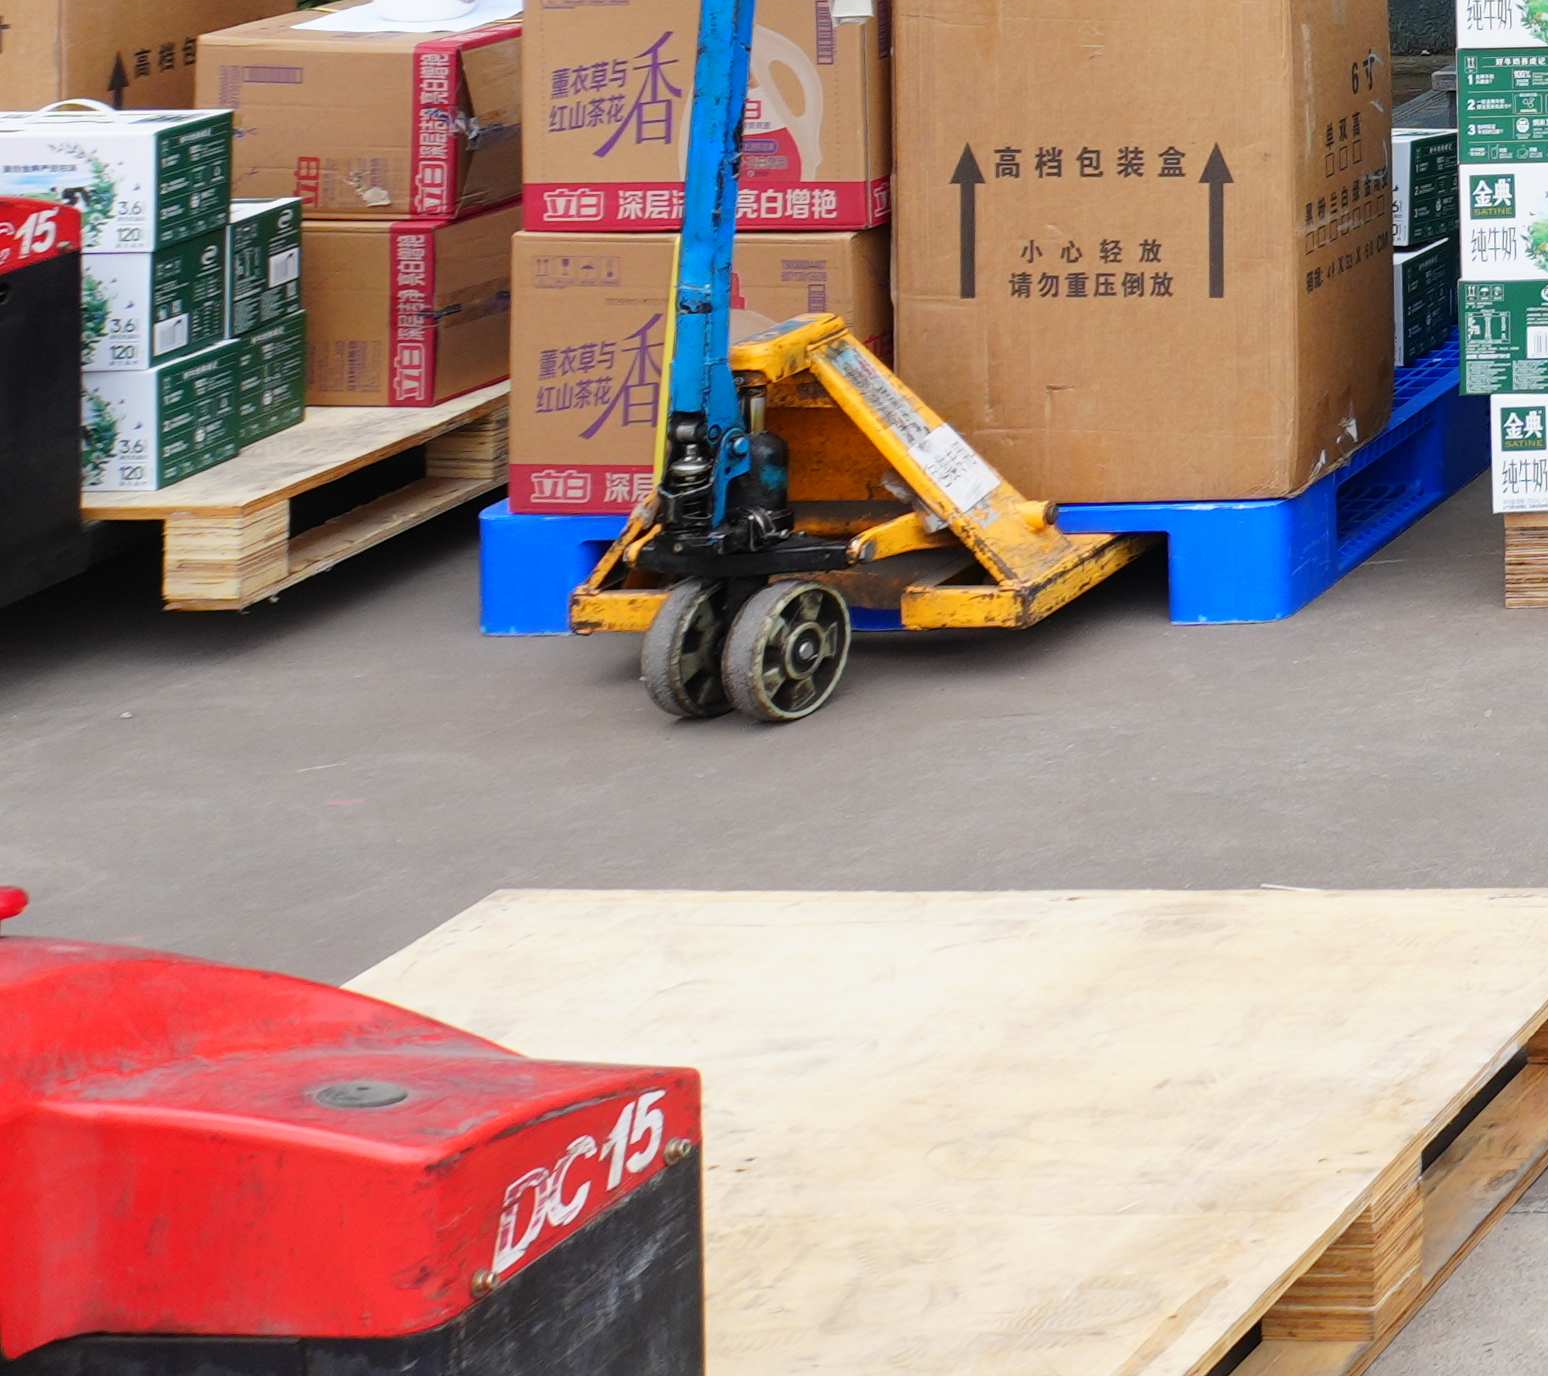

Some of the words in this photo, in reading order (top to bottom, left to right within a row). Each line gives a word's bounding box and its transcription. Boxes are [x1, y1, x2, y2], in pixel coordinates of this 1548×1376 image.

[551, 59, 626, 98] 薰衣草与
[594, 30, 683, 158] 香
[548, 97, 625, 133] 红山茶花
[994, 147, 1187, 178] 高档包装盒
[543, 188, 604, 221] 立白
[1474, 178, 1513, 206] 金典
[1020, 239, 1163, 264] 小心轻放
[1471, 227, 1517, 263] 纯牛奶
[1008, 271, 1175, 299] 请勿重压倒放
[538, 341, 614, 379] 薰衣草与
[579, 312, 663, 439] 香
[535, 378, 612, 414] 红山茶花
[1505, 412, 1544, 440] 金典
[530, 470, 591, 503] 立白
[1502, 460, 1548, 496] 纯牛奶
